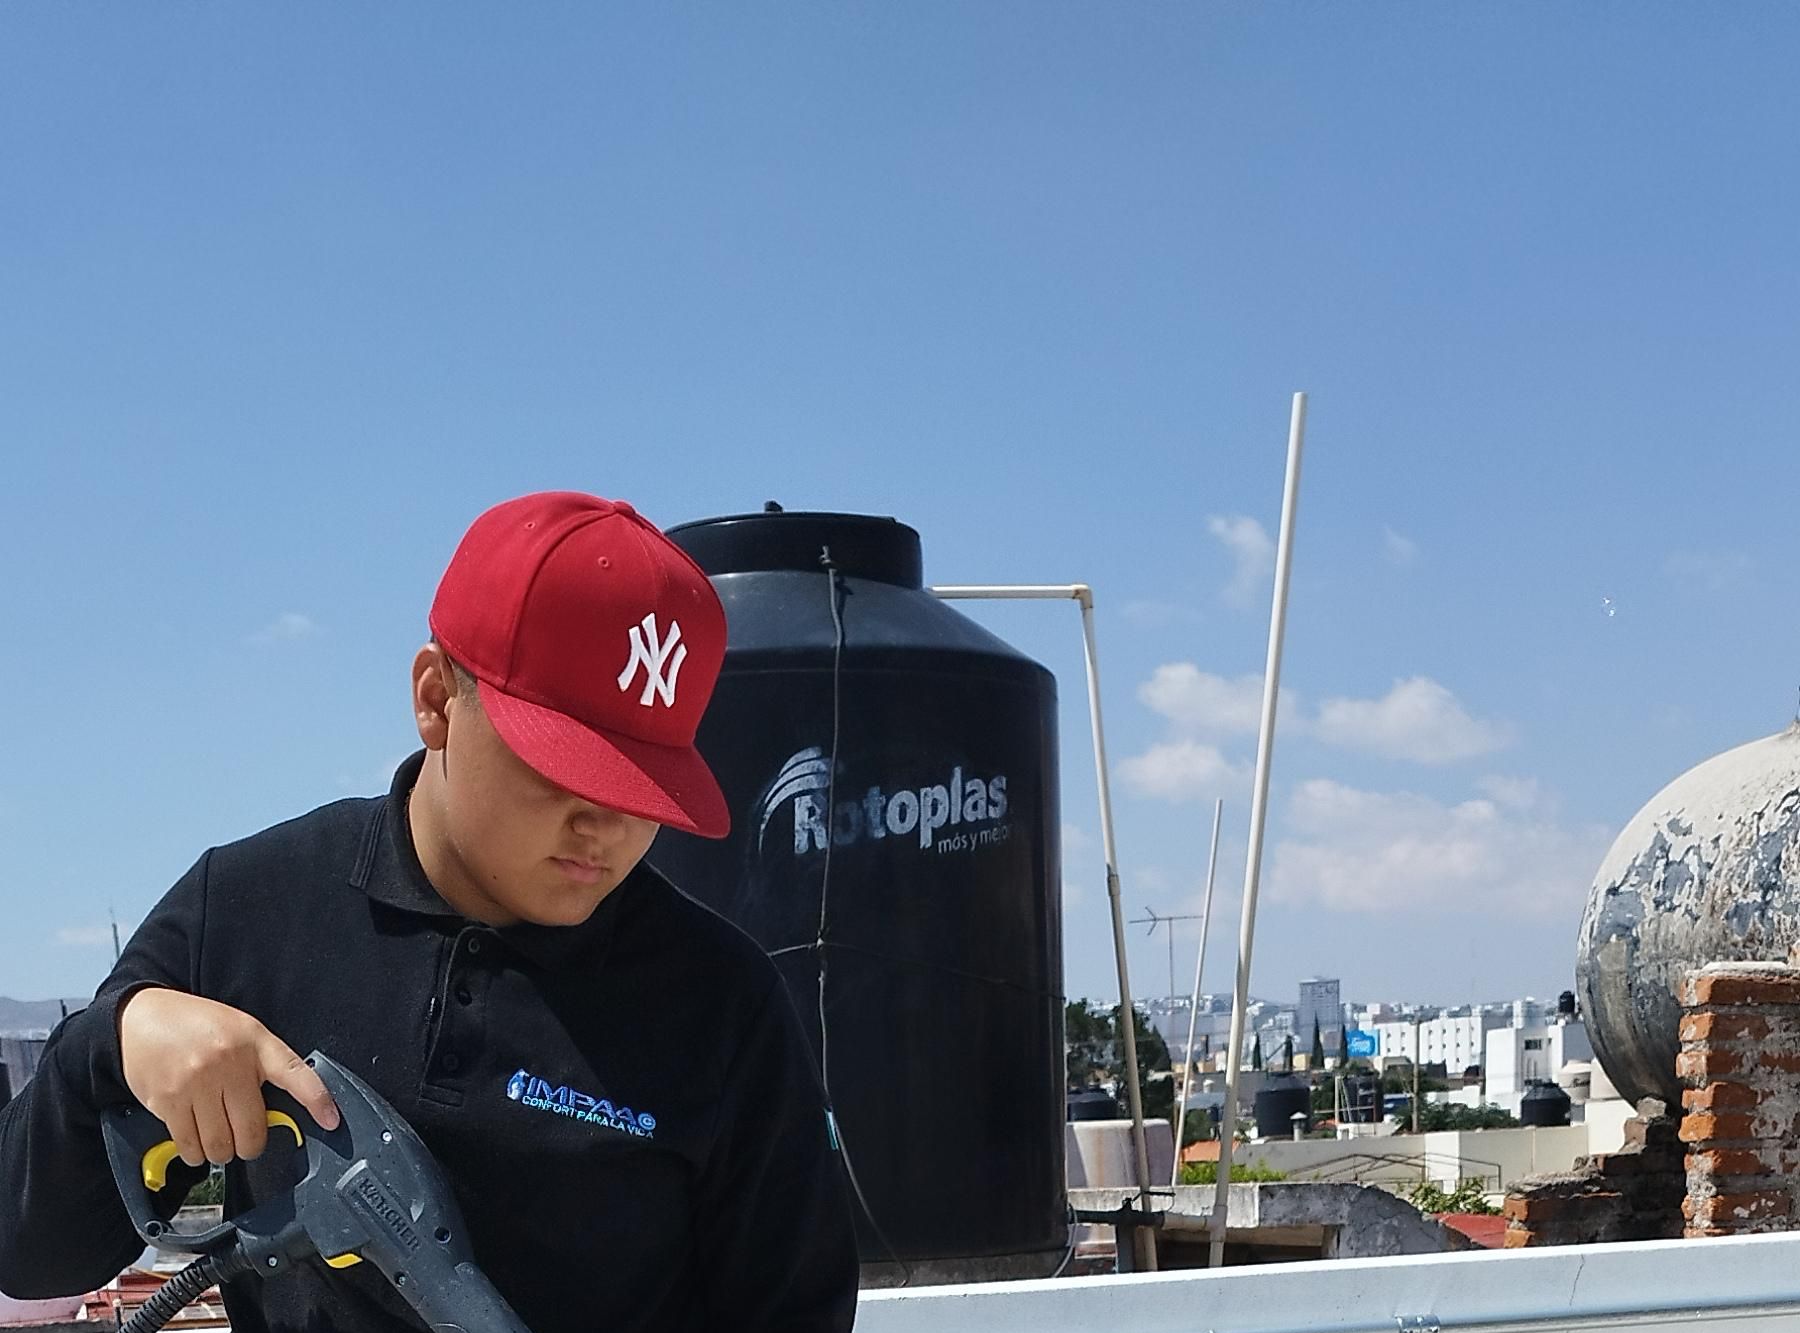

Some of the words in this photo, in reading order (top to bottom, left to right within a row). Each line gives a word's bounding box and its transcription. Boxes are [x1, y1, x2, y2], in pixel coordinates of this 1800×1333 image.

[617, 612, 687, 708] NY
[794, 766, 1008, 854] Rotoplas
[576, 1111, 608, 1126] PARA
[610, 1118, 625, 1132] LA
